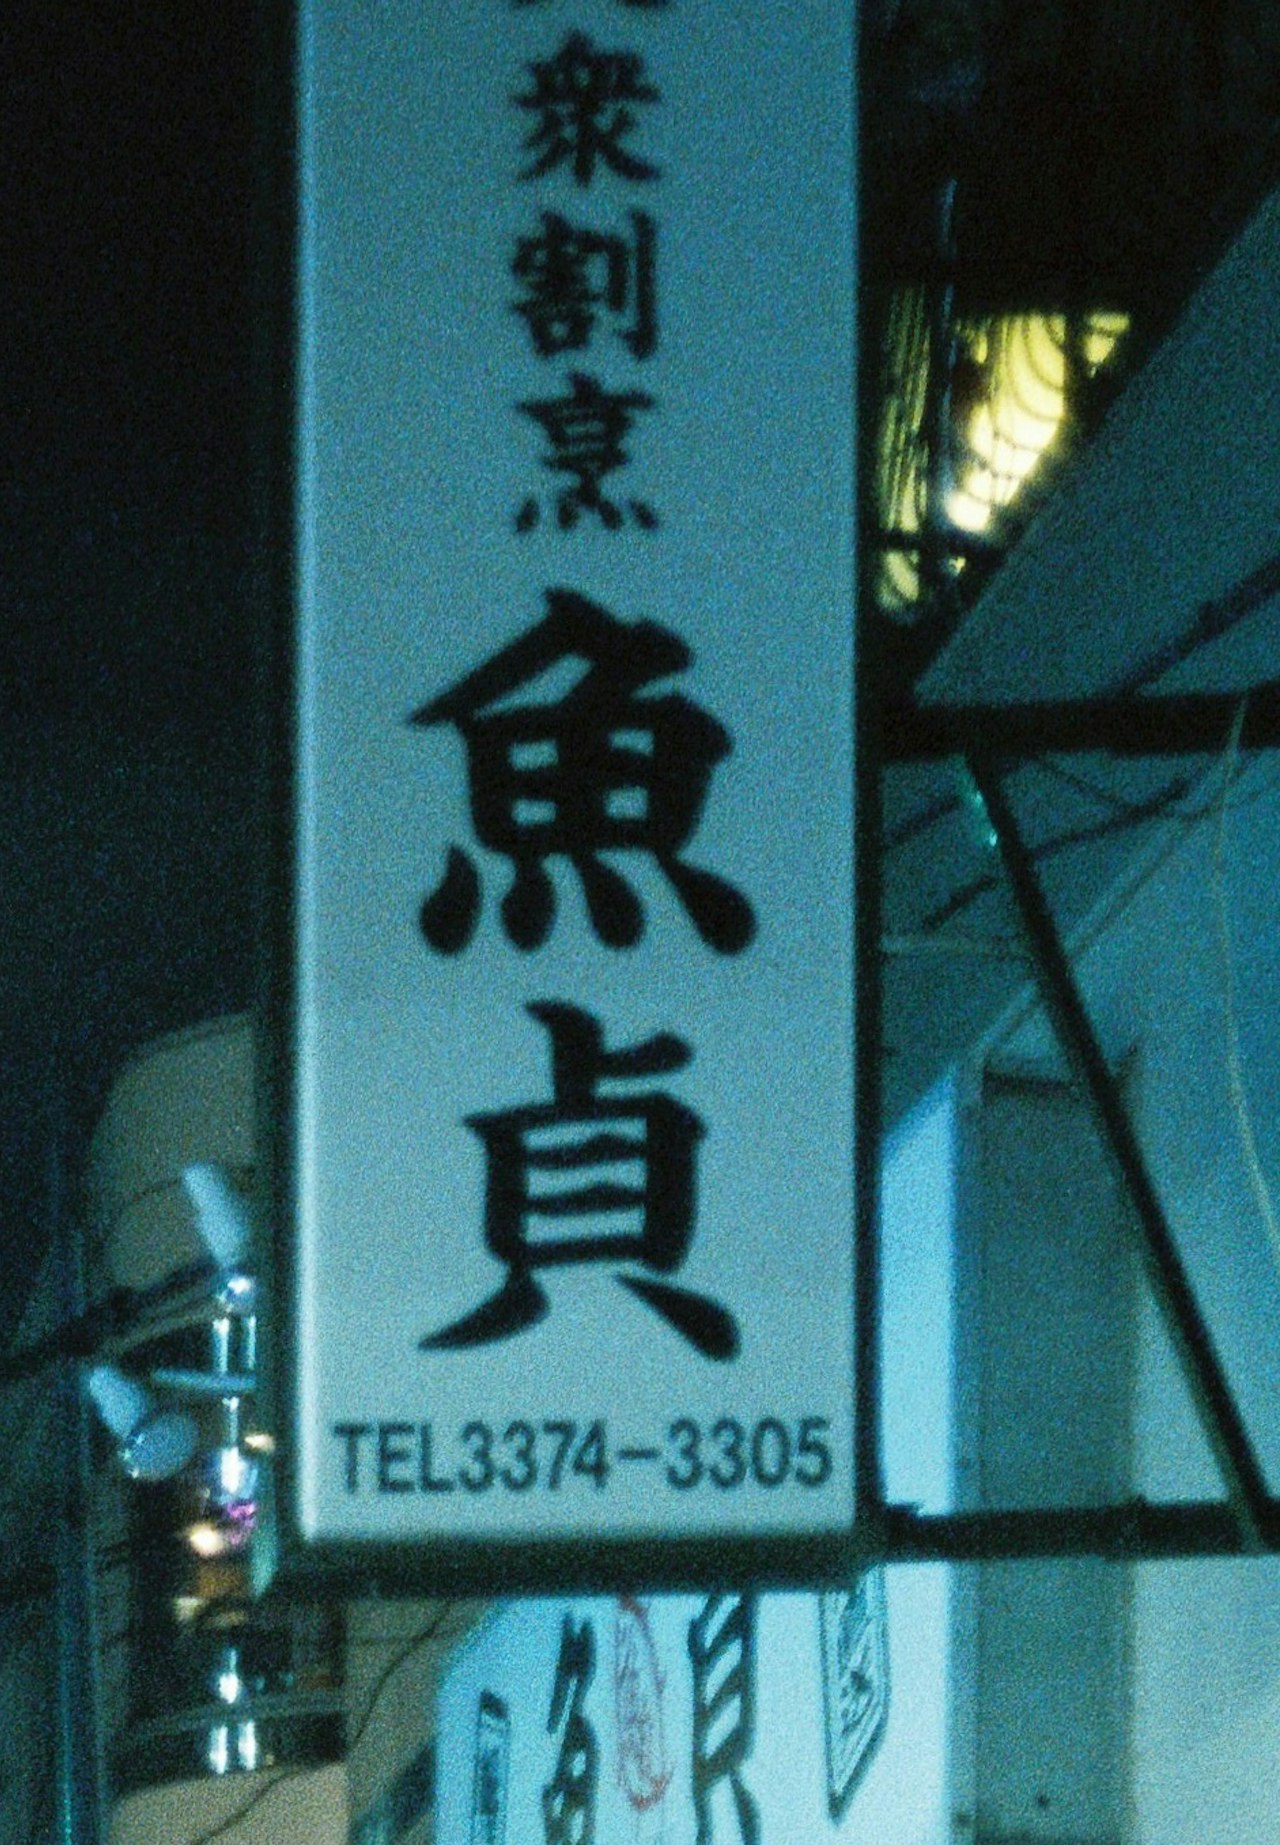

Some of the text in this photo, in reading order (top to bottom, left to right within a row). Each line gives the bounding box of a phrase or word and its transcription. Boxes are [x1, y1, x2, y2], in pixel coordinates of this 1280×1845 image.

[512, 0, 661, 532] 衆割烹
[408, 590, 759, 1360] 魚貞
